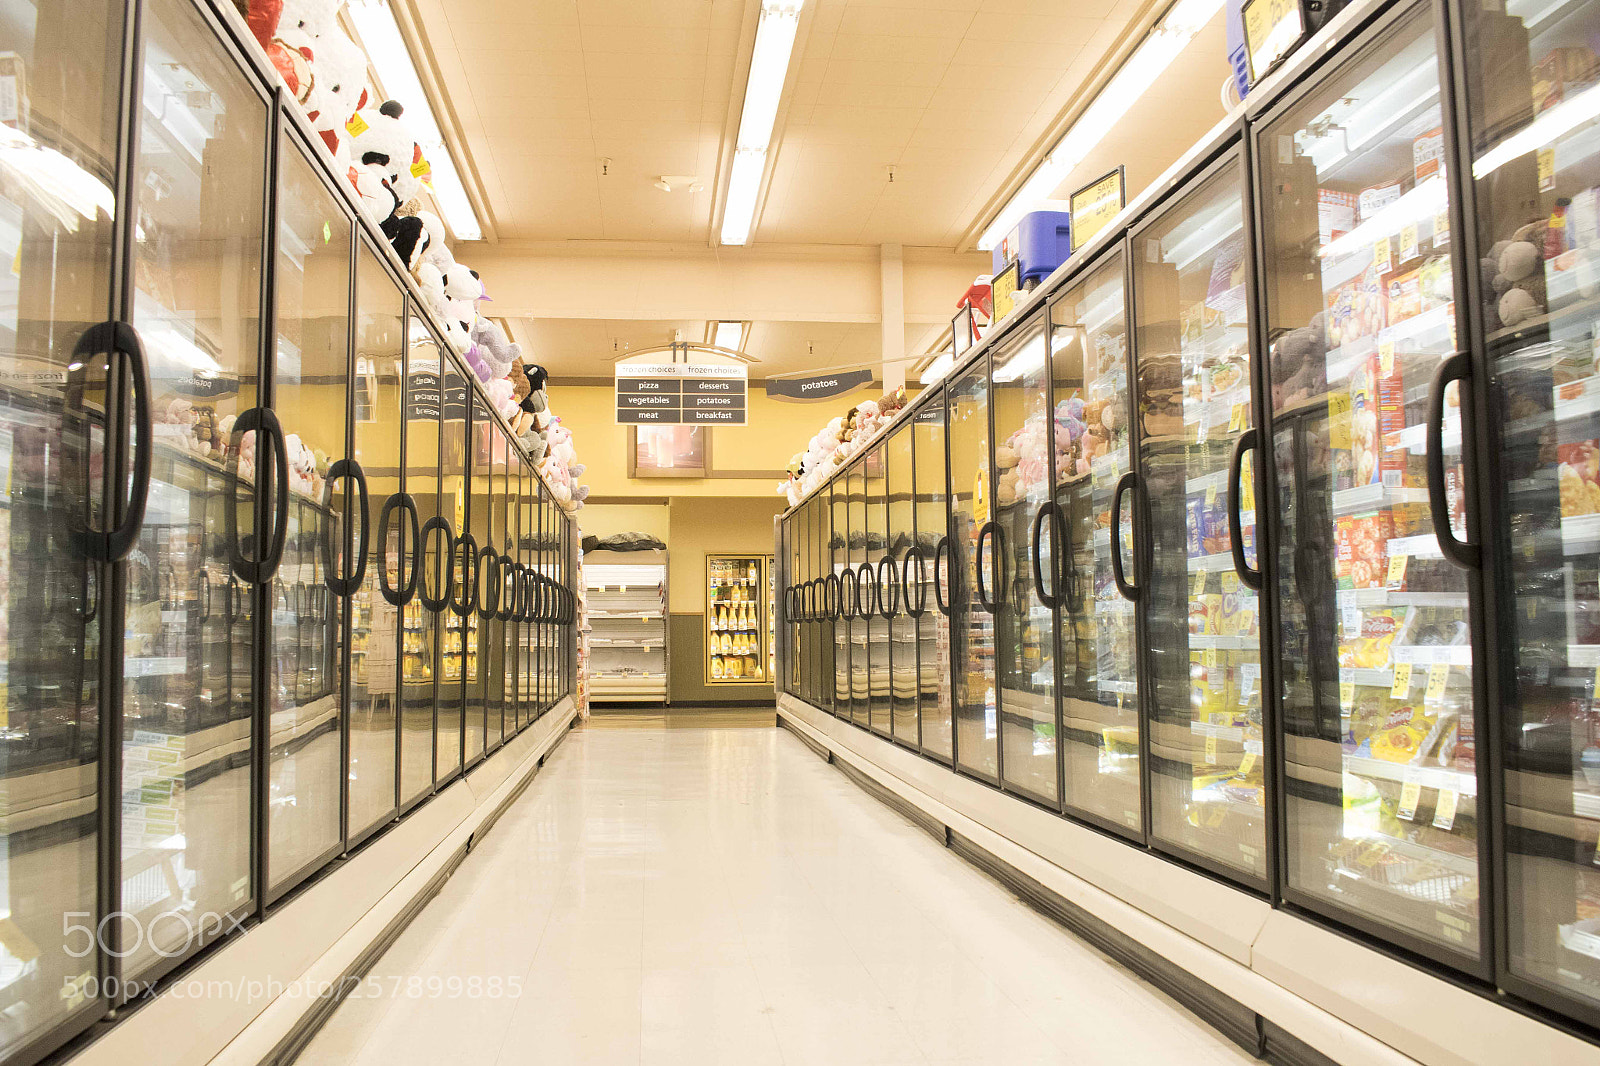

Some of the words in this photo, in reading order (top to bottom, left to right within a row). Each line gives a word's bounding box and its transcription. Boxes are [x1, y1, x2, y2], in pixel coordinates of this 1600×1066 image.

[668, 341, 688, 364] 11
[688, 366, 713, 374] frozen
[714, 367, 741, 375] choices
[638, 381, 660, 391] pizza
[699, 382, 730, 390] desserts
[801, 379, 838, 393] potatoes
[628, 396, 670, 406] vegetables
[696, 397, 731, 406] potatoes
[696, 411, 733, 419] breakfast
